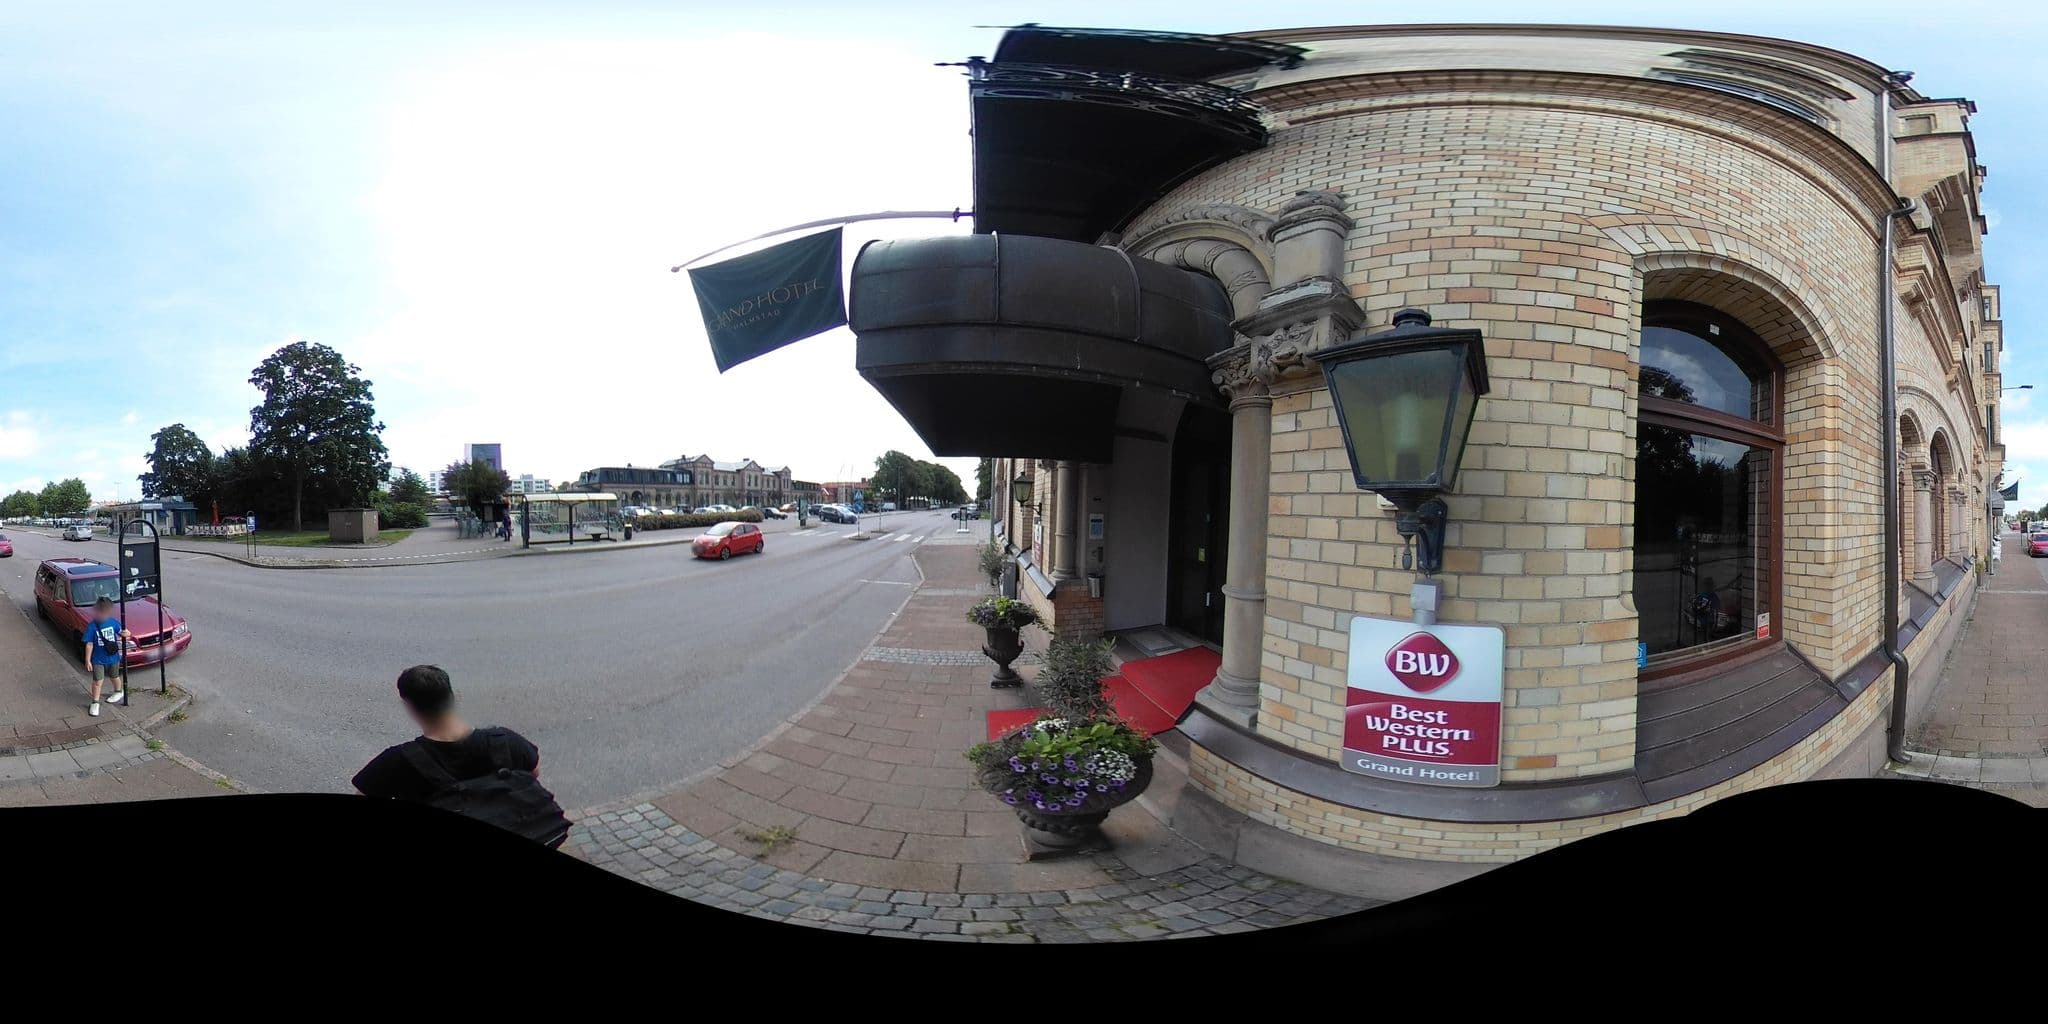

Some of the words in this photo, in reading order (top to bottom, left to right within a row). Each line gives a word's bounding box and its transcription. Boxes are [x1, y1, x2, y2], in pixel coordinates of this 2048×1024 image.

[757, 278, 825, 309] HOTEL
[1395, 649, 1450, 677] BW
[1390, 703, 1449, 725] Best
[1365, 714, 1472, 741] Western
[1382, 734, 1451, 756] PLUS
[1356, 758, 1415, 776] Grand
[1419, 768, 1475, 781] Hotel
